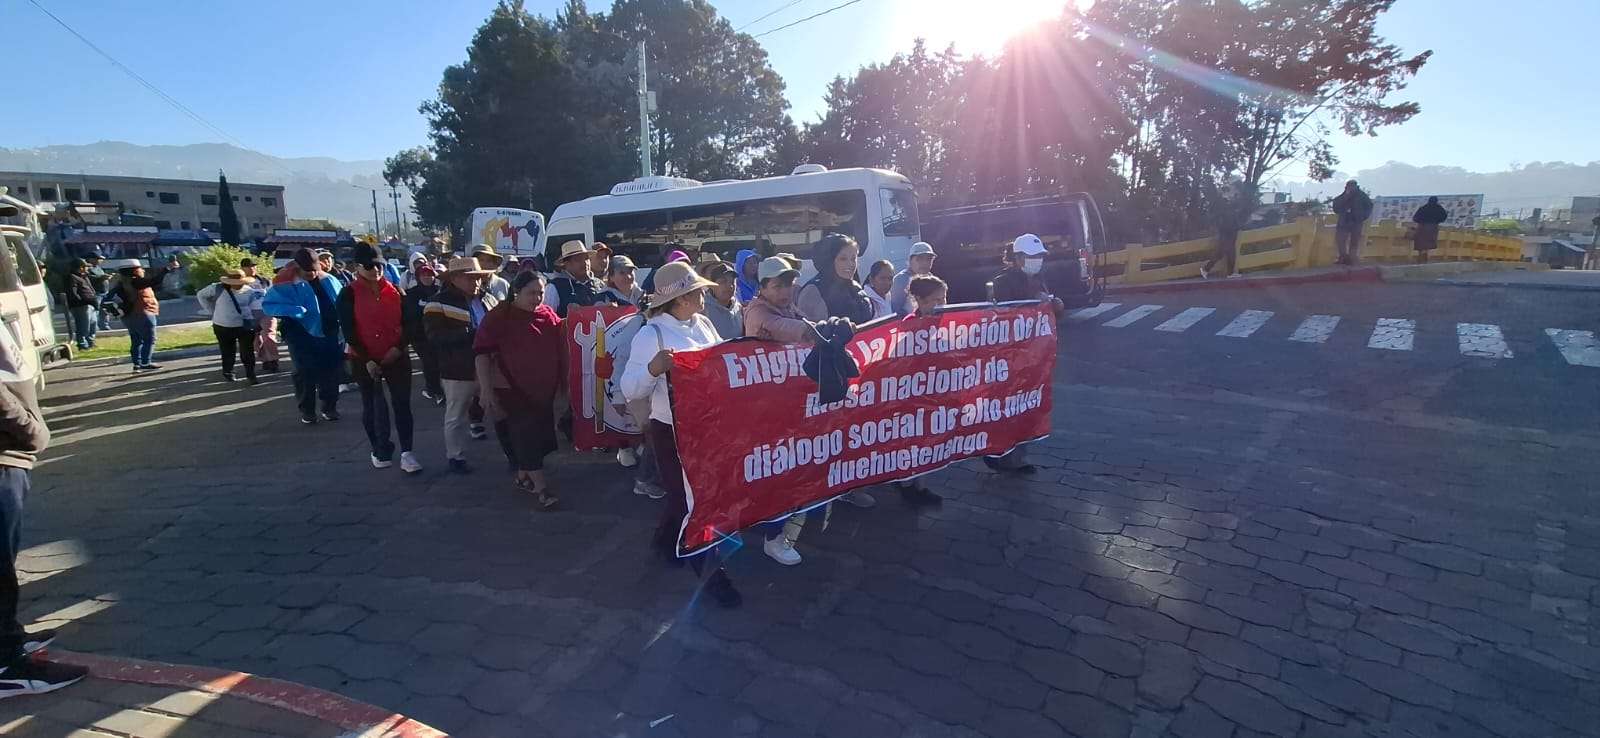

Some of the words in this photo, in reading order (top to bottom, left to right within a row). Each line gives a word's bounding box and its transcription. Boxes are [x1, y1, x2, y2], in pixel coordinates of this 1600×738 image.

[856, 337, 885, 365] la
[888, 313, 1010, 358] instalación
[1013, 315, 1034, 341] de
[1035, 312, 1053, 337] la
[805, 380, 875, 418] msa
[880, 359, 980, 402] nacional
[984, 356, 1009, 384] de
[744, 430, 843, 482] diálogo
[848, 408, 924, 449] social
[960, 398, 1001, 427] alto
[1003, 384, 1045, 418] nivel
[827, 431, 988, 488] Huehuetenango
